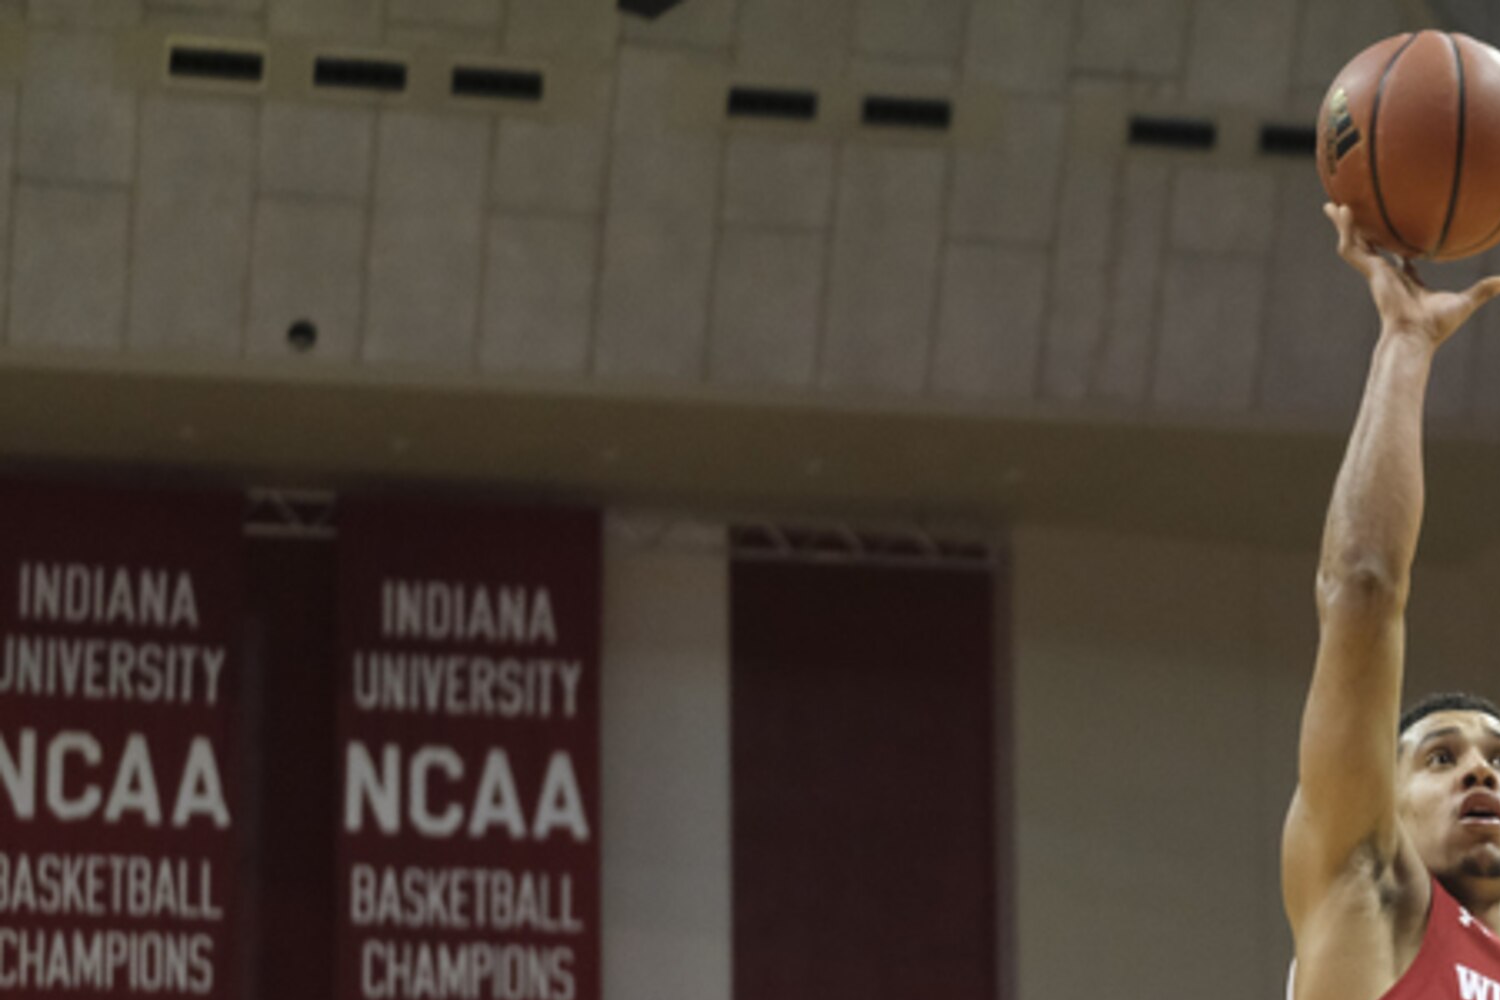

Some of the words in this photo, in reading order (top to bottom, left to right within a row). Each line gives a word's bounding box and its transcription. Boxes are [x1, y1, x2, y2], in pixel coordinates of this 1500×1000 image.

[20, 563, 198, 627] INDIANA
[383, 581, 557, 643] INDIANA
[355, 653, 581, 717] UNIVERSITY
[0, 729, 230, 828] NCAA
[345, 742, 588, 841] NCAA
[351, 865, 582, 932] BASKETBALL
[0, 929, 213, 993] CHAMPIONS
